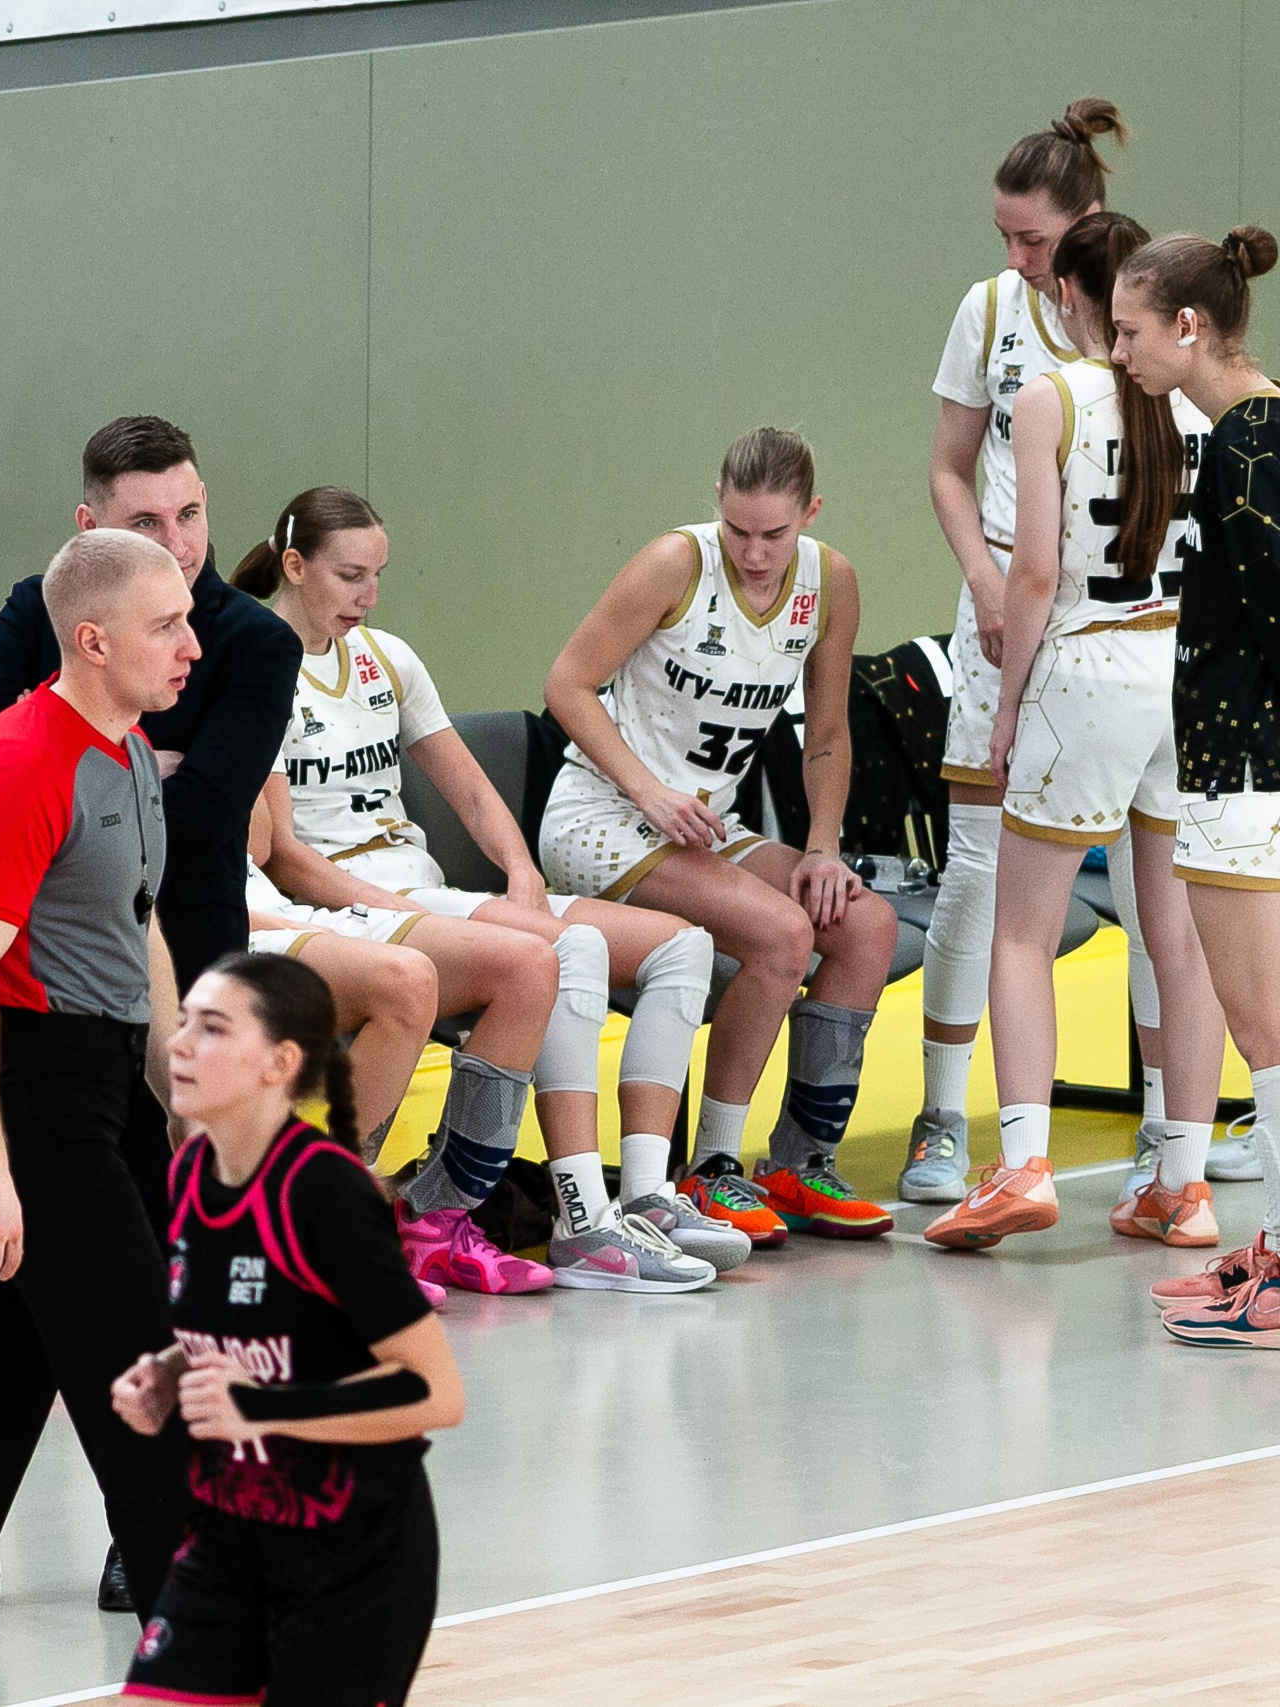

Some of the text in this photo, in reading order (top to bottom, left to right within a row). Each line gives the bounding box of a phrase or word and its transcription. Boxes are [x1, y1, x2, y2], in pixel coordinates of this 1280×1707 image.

[685, 721, 767, 776] 32
[555, 1172, 592, 1235] ARMOU
[227, 1280, 267, 1305] BET
